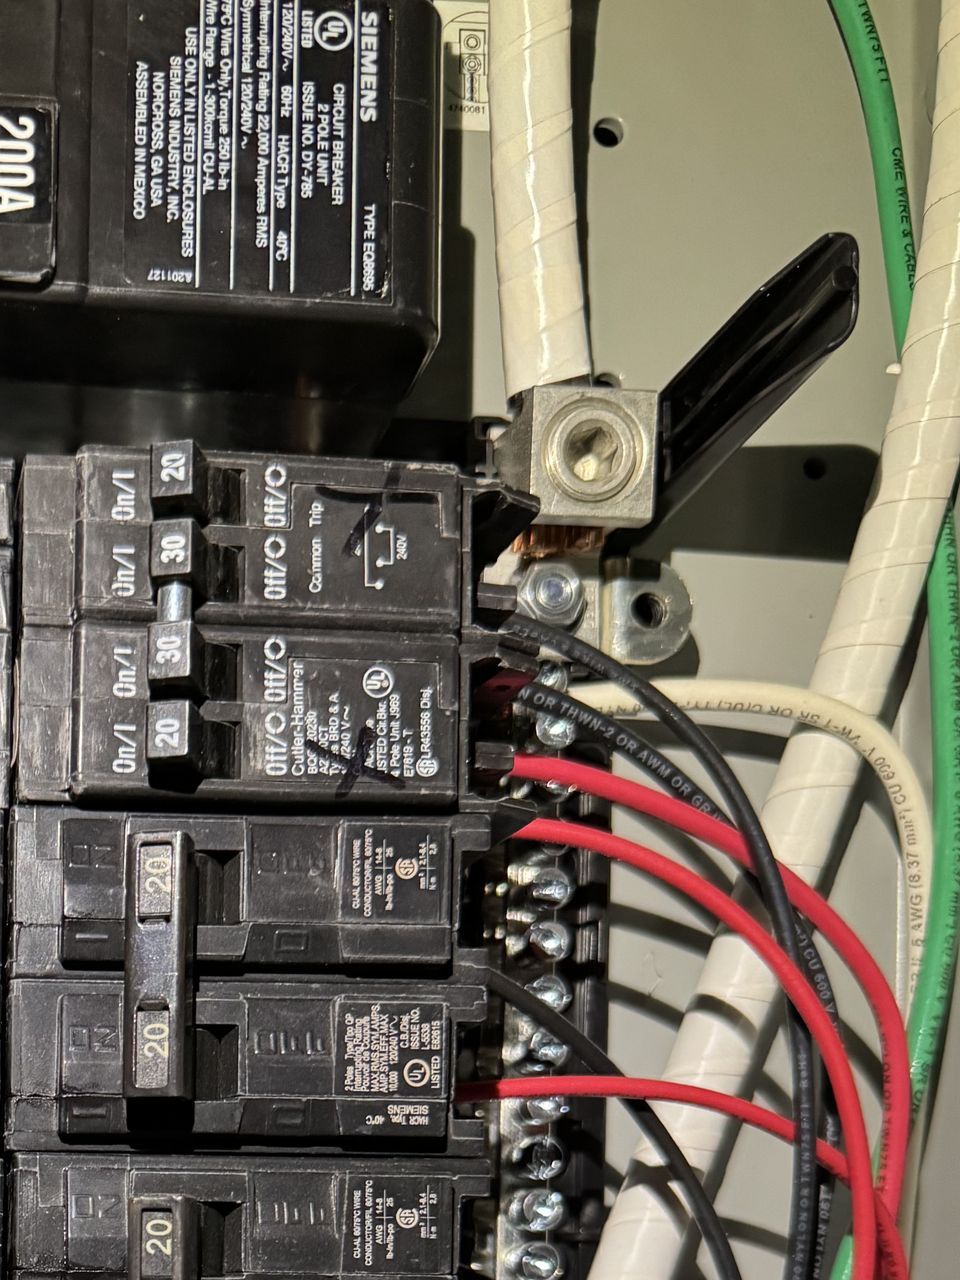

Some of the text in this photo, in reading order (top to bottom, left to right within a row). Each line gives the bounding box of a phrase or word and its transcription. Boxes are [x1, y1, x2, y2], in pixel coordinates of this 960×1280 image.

[203, 27, 217, 68] Range
[240, 0, 255, 73] Symmetrical
[301, 10, 314, 49] LISTED
[359, 11, 379, 123] SIEMENS
[218, 28, 232, 191] Wire 250 lb-in
[255, 71, 271, 112] Rating
[280, 85, 293, 118] 60Hz
[133, 61, 148, 220] ASSEMBLED IN MEXICO
[149, 72, 165, 207] NORCROSS, GA USA
[165, 56, 182, 223] SIEMENS INDUSTRY, INC.
[181, 27, 197, 257] USE ONLY IN LISTED ENCLOSURES
[256, 114, 270, 154] 22,000
[277, 134, 290, 174] HACR
[300, 81, 315, 199] ISSUE NO. DY-785
[316, 103, 329, 186] 2 POLE UNIT
[331, 83, 345, 205] CIRCUIT BREAKER
[202, 152, 215, 195] CU-AL
[254, 157, 270, 213] Amperes
[274, 176, 289, 209] Type
[364, 204, 376, 240] TYPE
[895, 186, 910, 224] WIRE
[255, 215, 268, 248] RMS
[161, 452, 186, 485] 20
[161, 534, 185, 566] 30
[308, 502, 325, 594] Common Trip
[395, 534, 408, 561] 240V
[156, 636, 181, 667] 30
[155, 717, 181, 751] 20
[290, 661, 305, 777] Cutler-Hammer
[328, 692, 339, 742] BRD & A
[390, 693, 400, 767] Pole Unit J969
[420, 686, 432, 759] LR43556 Disj.
[402, 745, 415, 778] E7819
[532, 693, 692, 798] OR THWN-2 OR AWM OR
[145, 855, 172, 895] 20
[802, 947, 831, 1000] CU 600
[144, 1021, 170, 1059] 20
[386, 1104, 430, 1115] SIEMENS
[145, 1218, 173, 1256] 20
[375, 1224, 383, 1245] AWG
